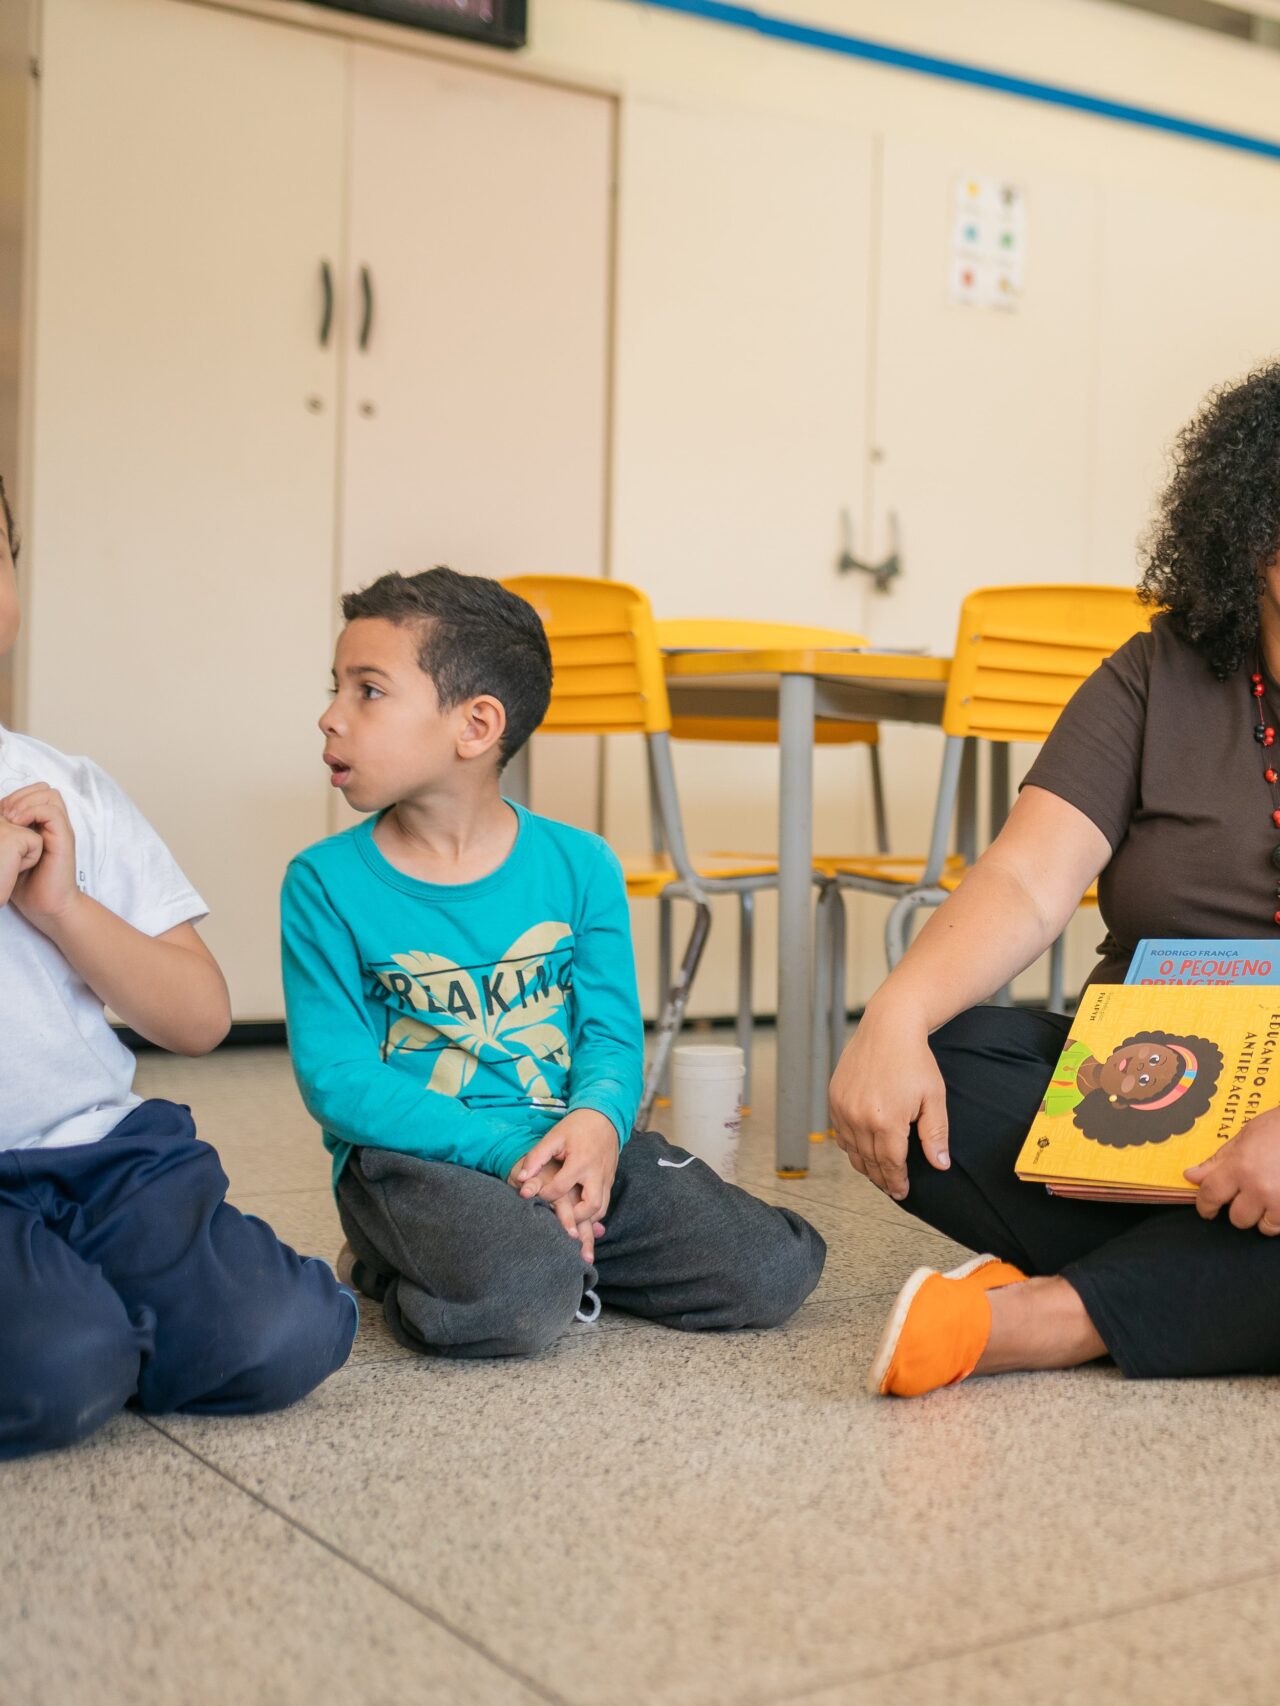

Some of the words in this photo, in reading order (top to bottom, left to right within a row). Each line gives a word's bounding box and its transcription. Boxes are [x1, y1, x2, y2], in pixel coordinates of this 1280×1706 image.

[1151, 949, 1197, 957] RODRIGO
[1198, 949, 1239, 958] FRANÇA
[1159, 960, 1174, 975] O
[1179, 960, 1272, 977] PEQUENO
[1216, 1032, 1258, 1140] ANTIRRACISTAS
[1241, 1092, 1262, 1125] CRIA
